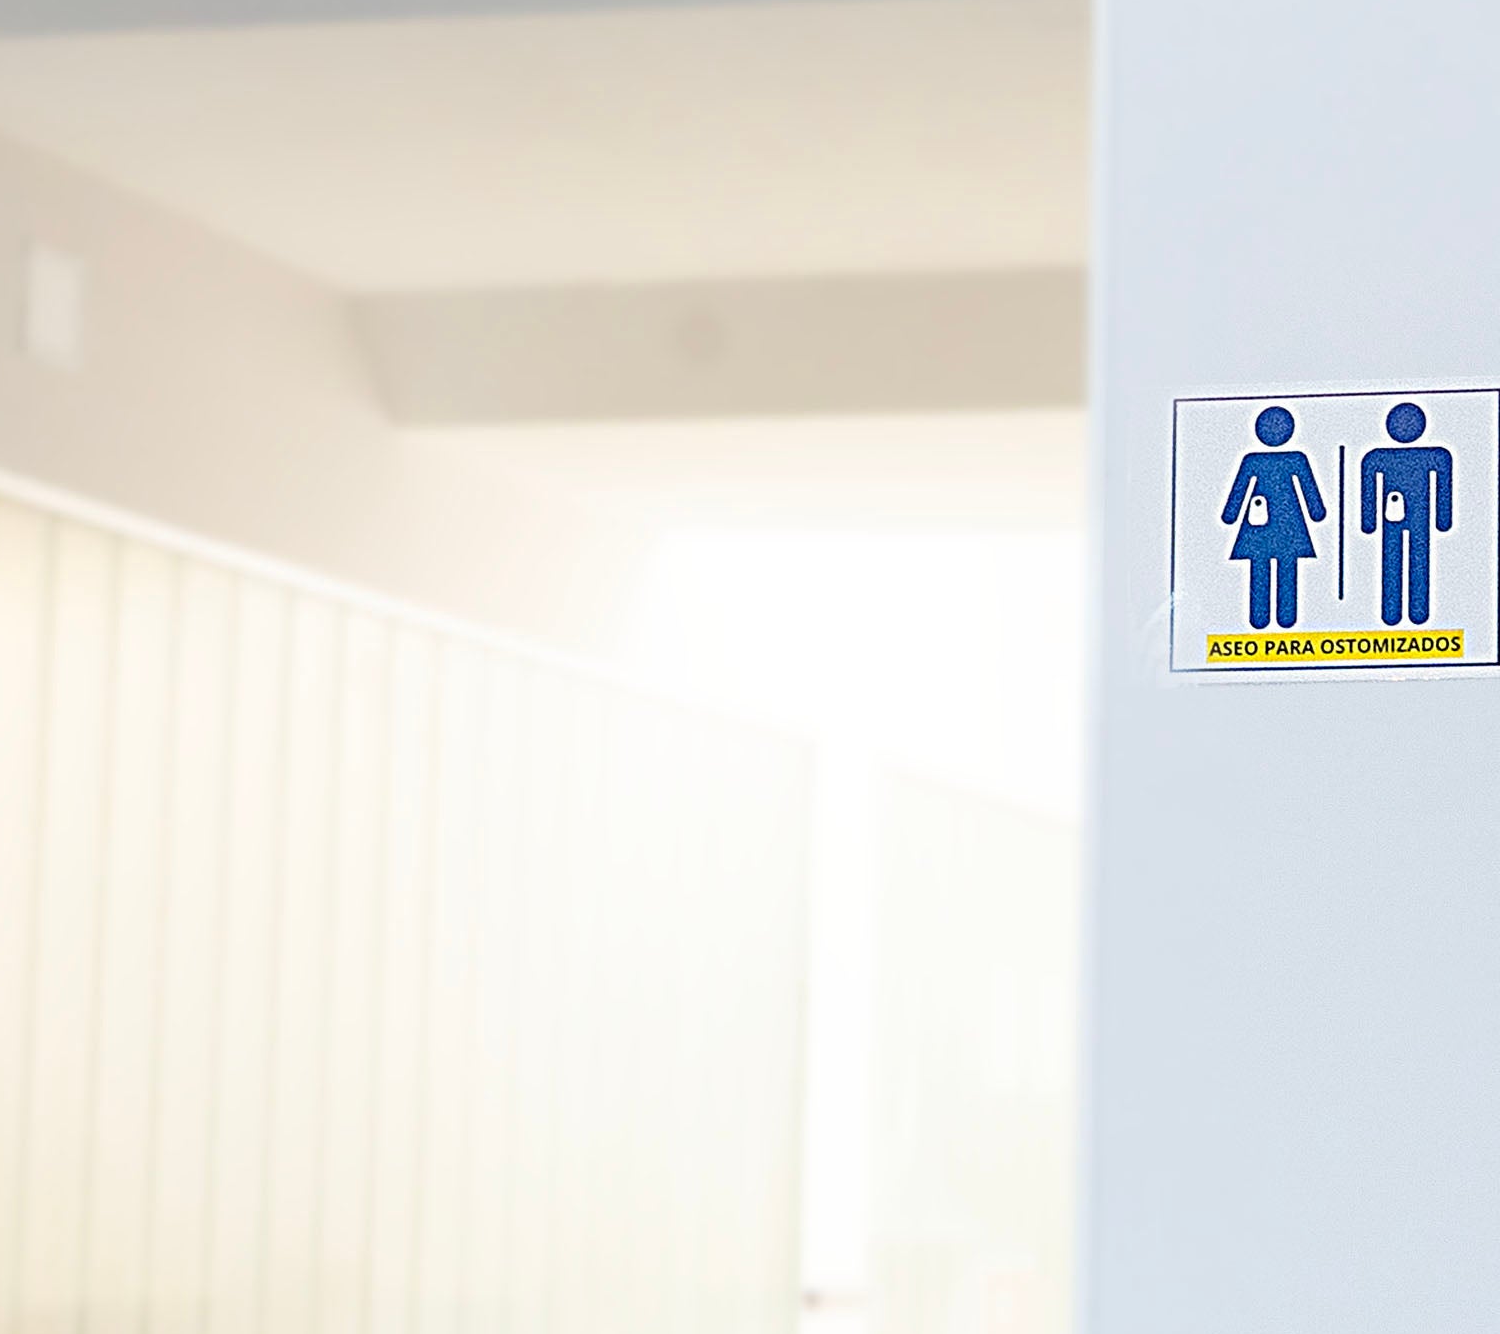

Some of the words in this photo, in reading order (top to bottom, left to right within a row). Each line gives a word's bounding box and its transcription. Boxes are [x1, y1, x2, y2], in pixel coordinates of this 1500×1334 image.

[1209, 640, 1259, 657] ASEO
[1264, 639, 1315, 656] PARA
[1321, 636, 1461, 654] OSTOMIZADOS
